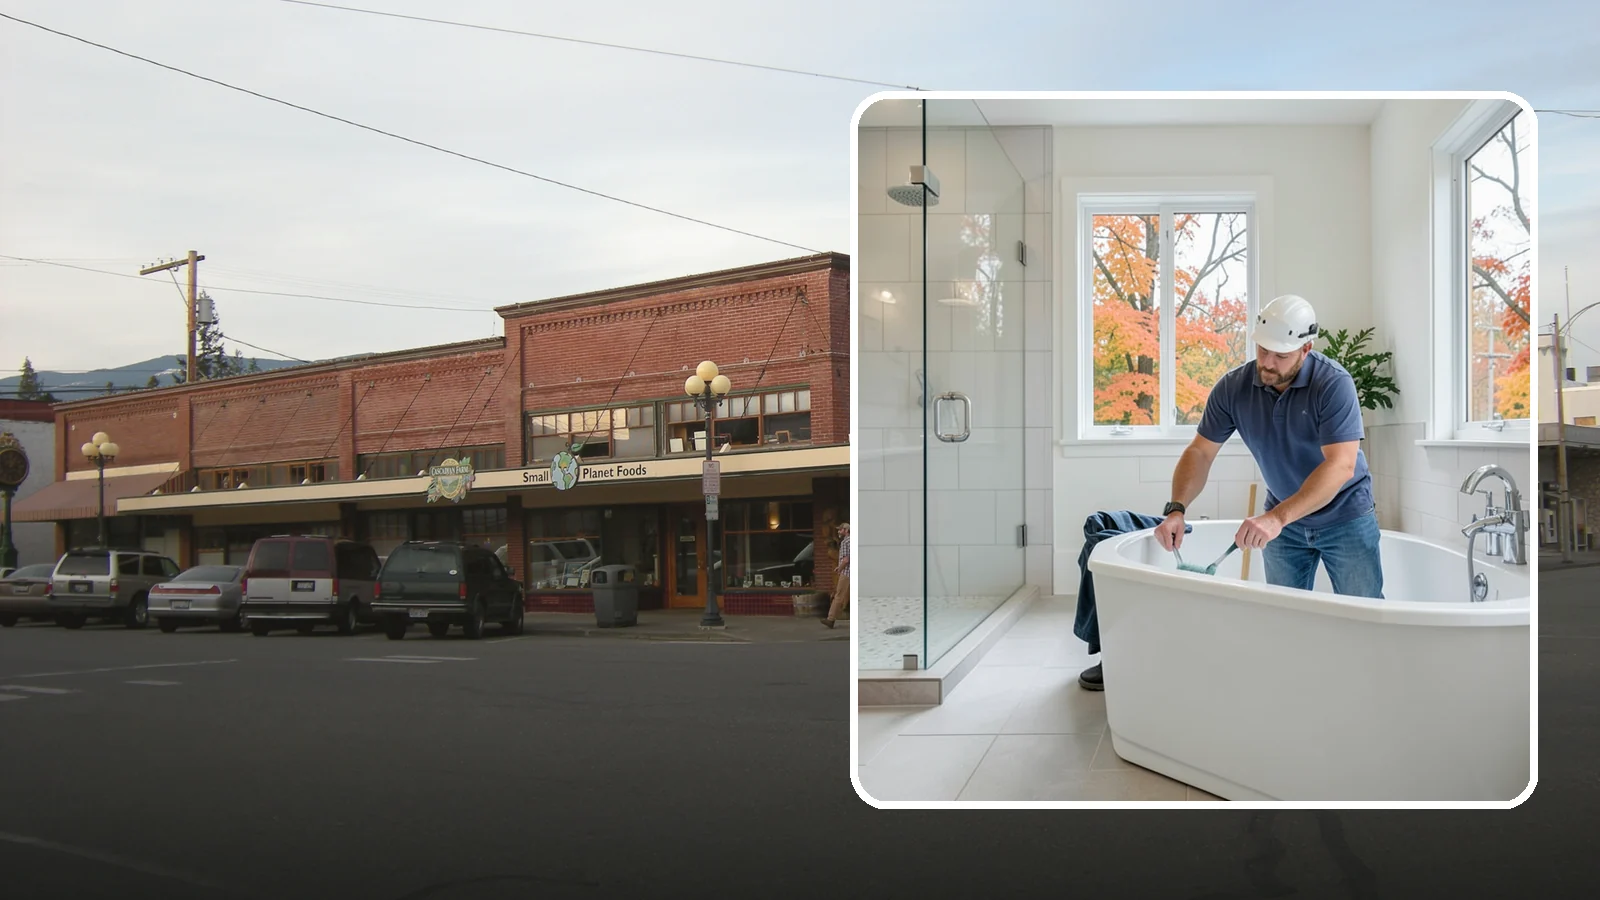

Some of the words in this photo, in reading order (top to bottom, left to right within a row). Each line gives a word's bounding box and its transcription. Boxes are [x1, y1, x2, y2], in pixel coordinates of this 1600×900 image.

[523, 472, 549, 483] Small
[583, 468, 614, 479] Planet
[617, 464, 647, 477] Foods
